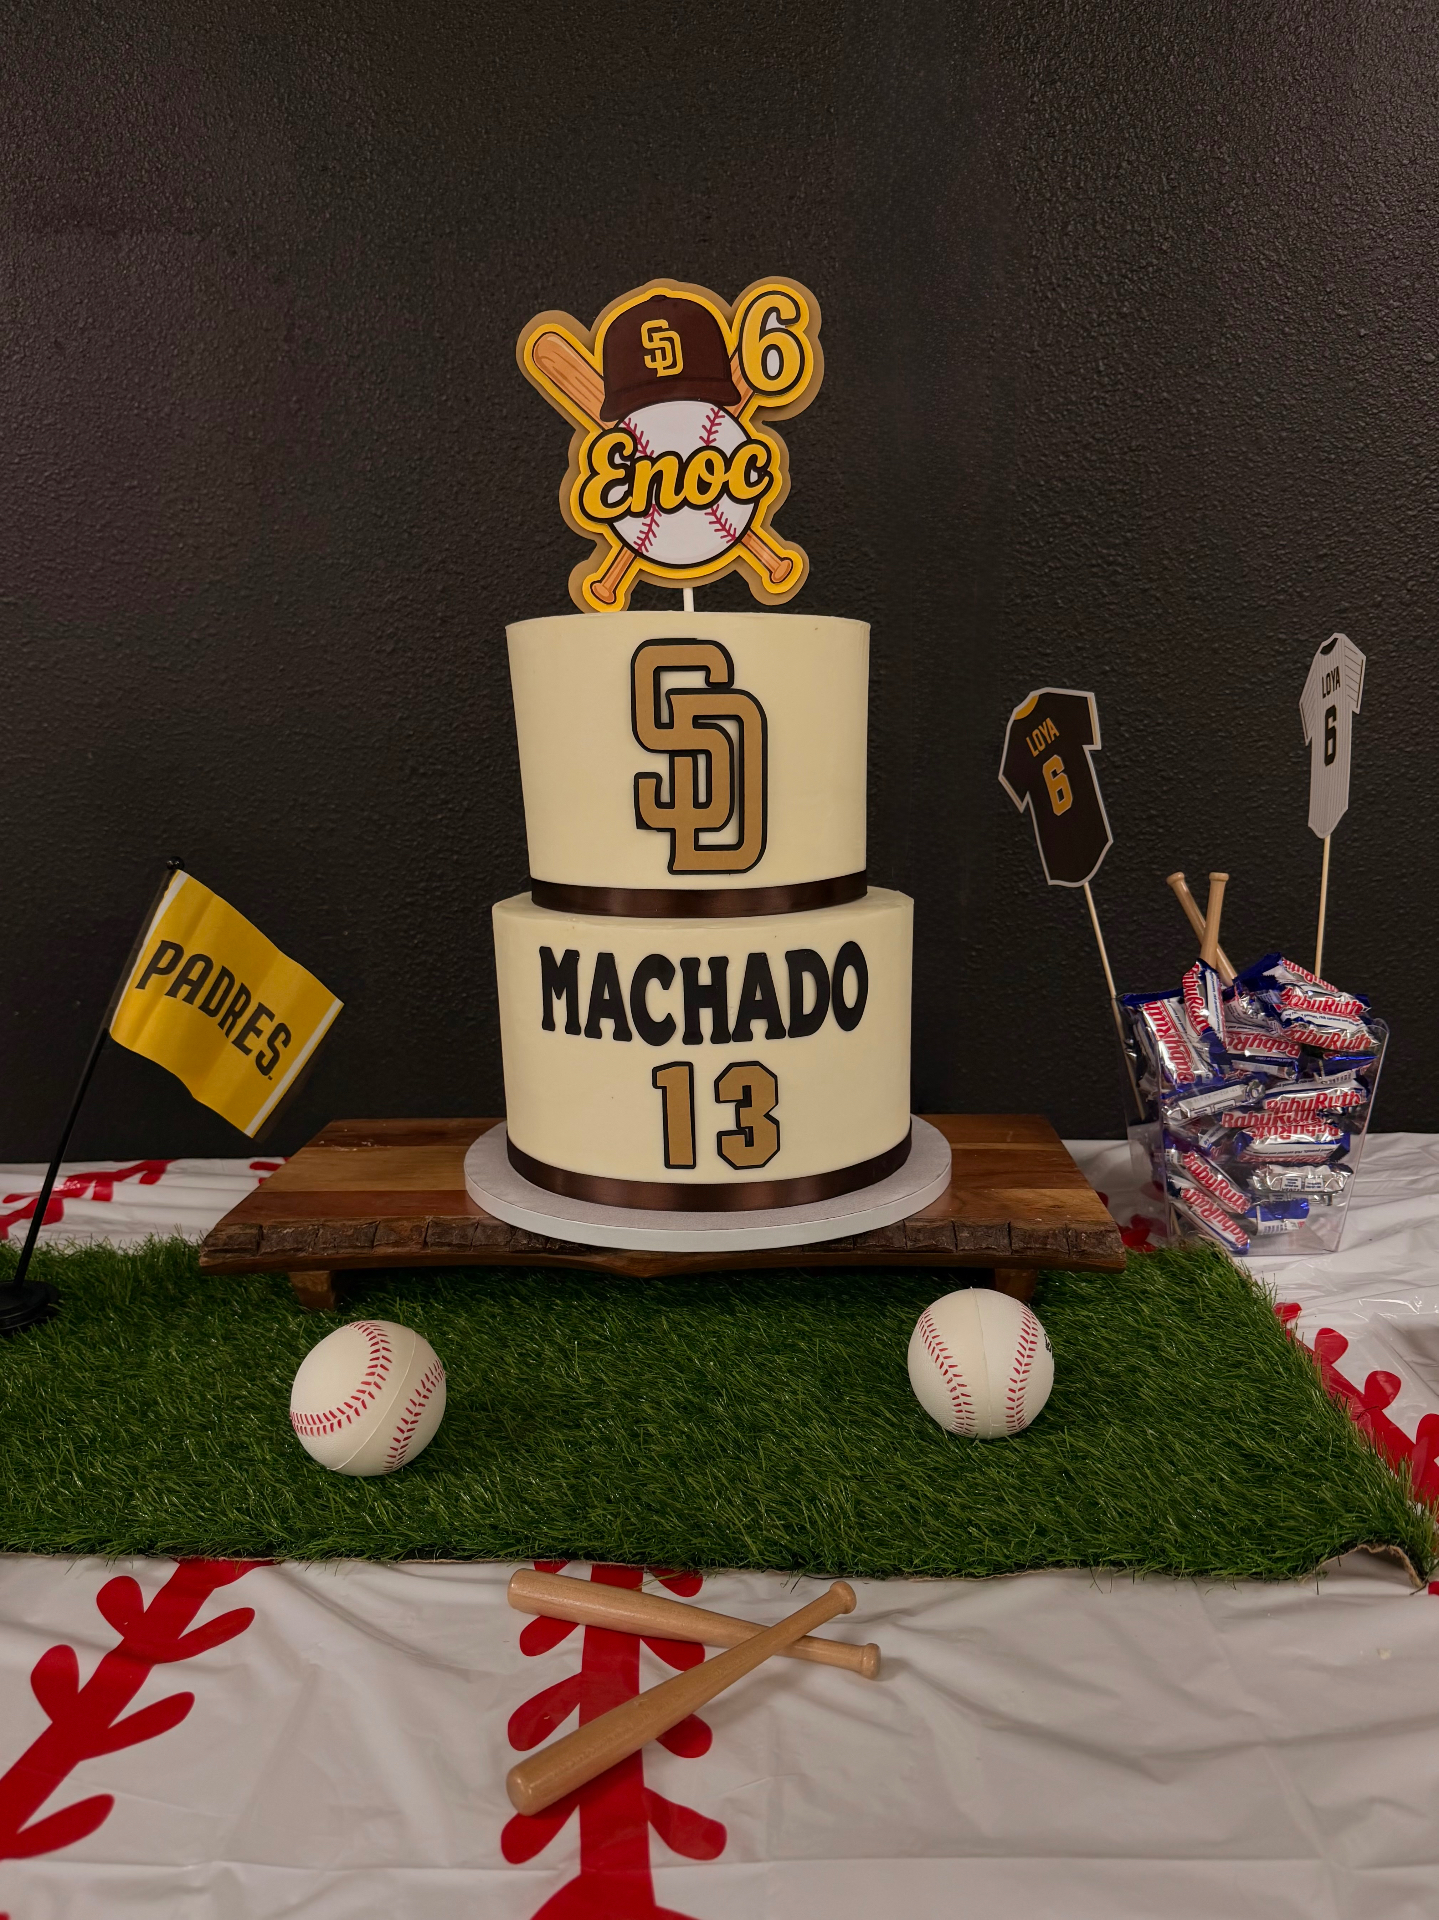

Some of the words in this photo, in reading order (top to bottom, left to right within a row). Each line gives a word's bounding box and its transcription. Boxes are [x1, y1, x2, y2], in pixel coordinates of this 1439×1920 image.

[739, 290, 805, 396] 6
[580, 429, 773, 524] Enoc
[1322, 666, 1341, 699] LOYA
[631, 638, 767, 874] SD
[1025, 717, 1060, 757] LOYA
[1042, 754, 1073, 816] 6
[1324, 704, 1337, 766] 6
[135, 940, 292, 1078] PADRES
[539, 941, 868, 1046] MACHADO
[652, 1061, 780, 1170] 13
